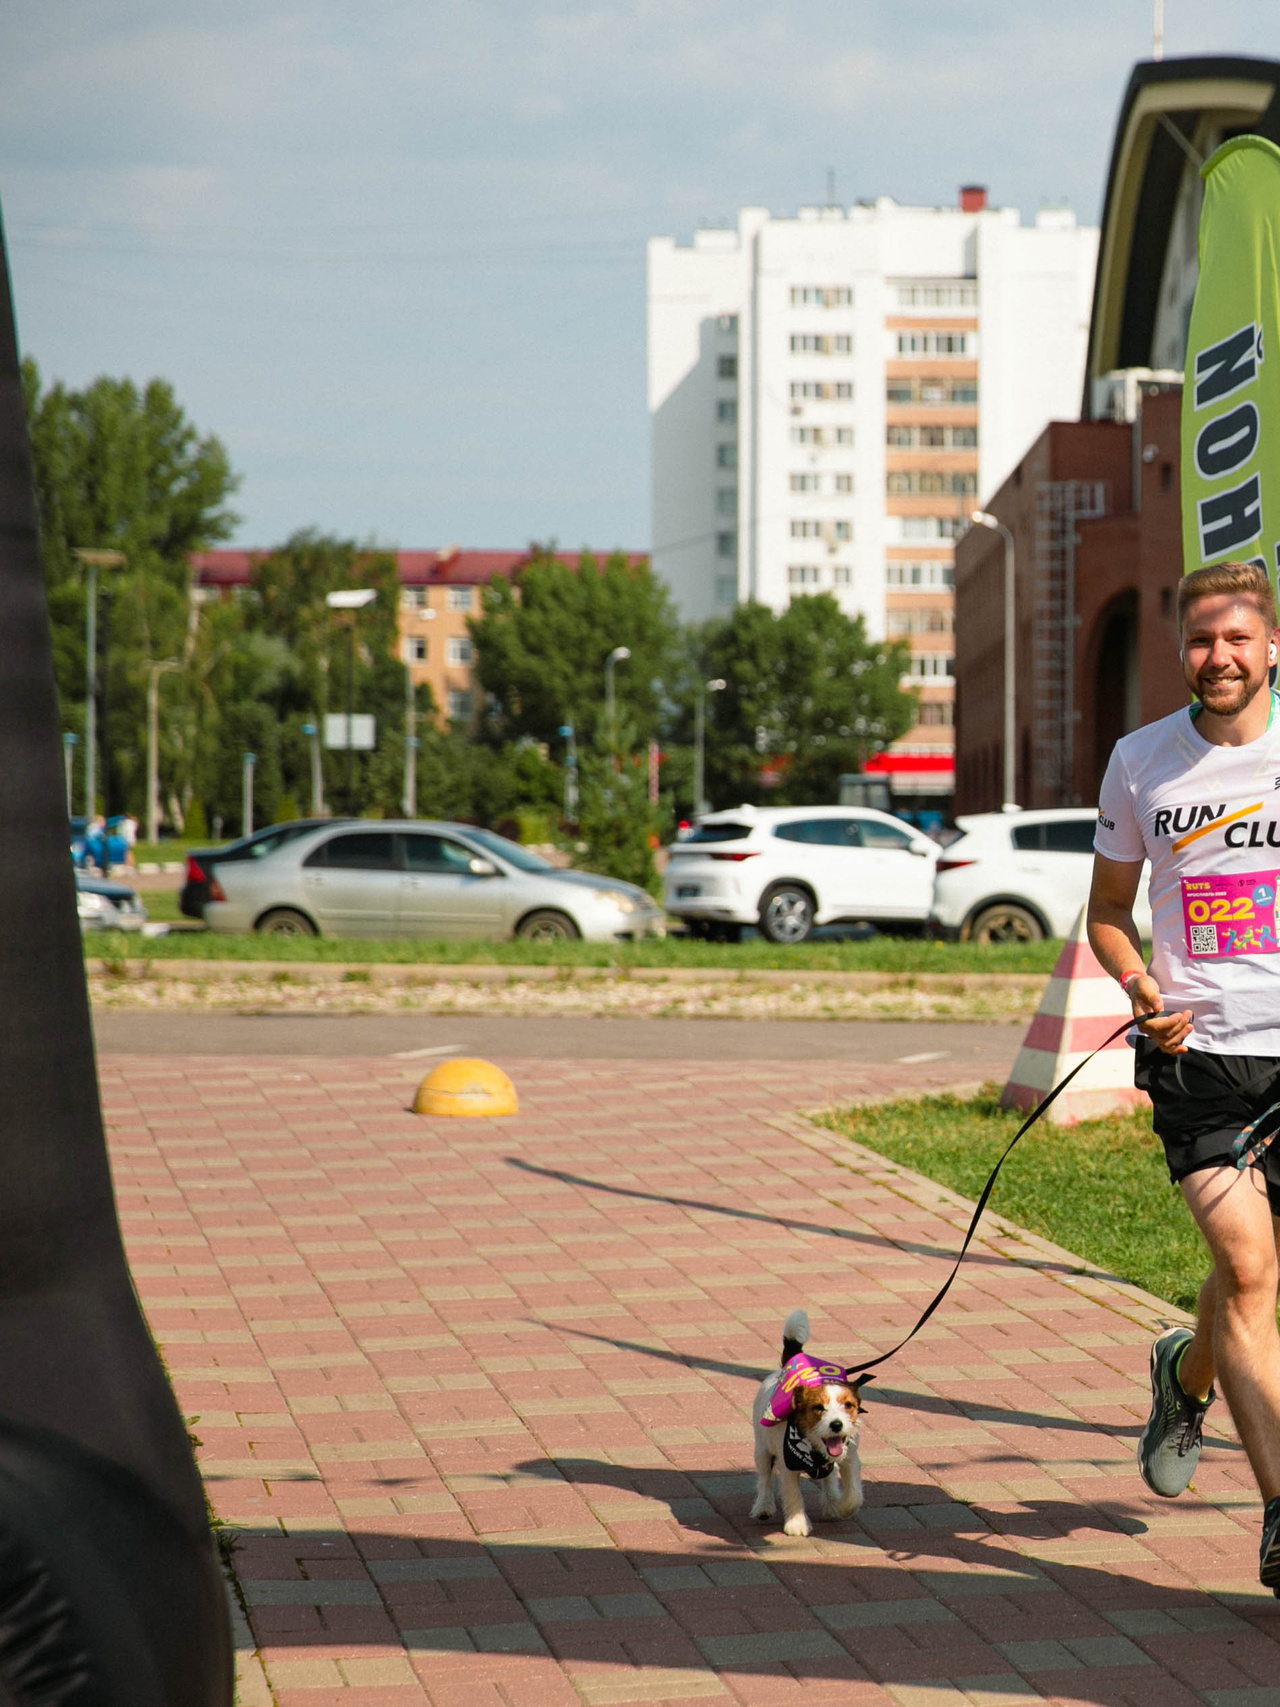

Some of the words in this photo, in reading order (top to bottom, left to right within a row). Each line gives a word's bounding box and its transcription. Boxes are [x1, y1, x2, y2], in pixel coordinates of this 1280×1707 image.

[1155, 804, 1226, 836] RUN
[1186, 882, 1211, 890] RUTS
[1258, 888, 1266, 897] 1
[1188, 897, 1255, 923] 022
